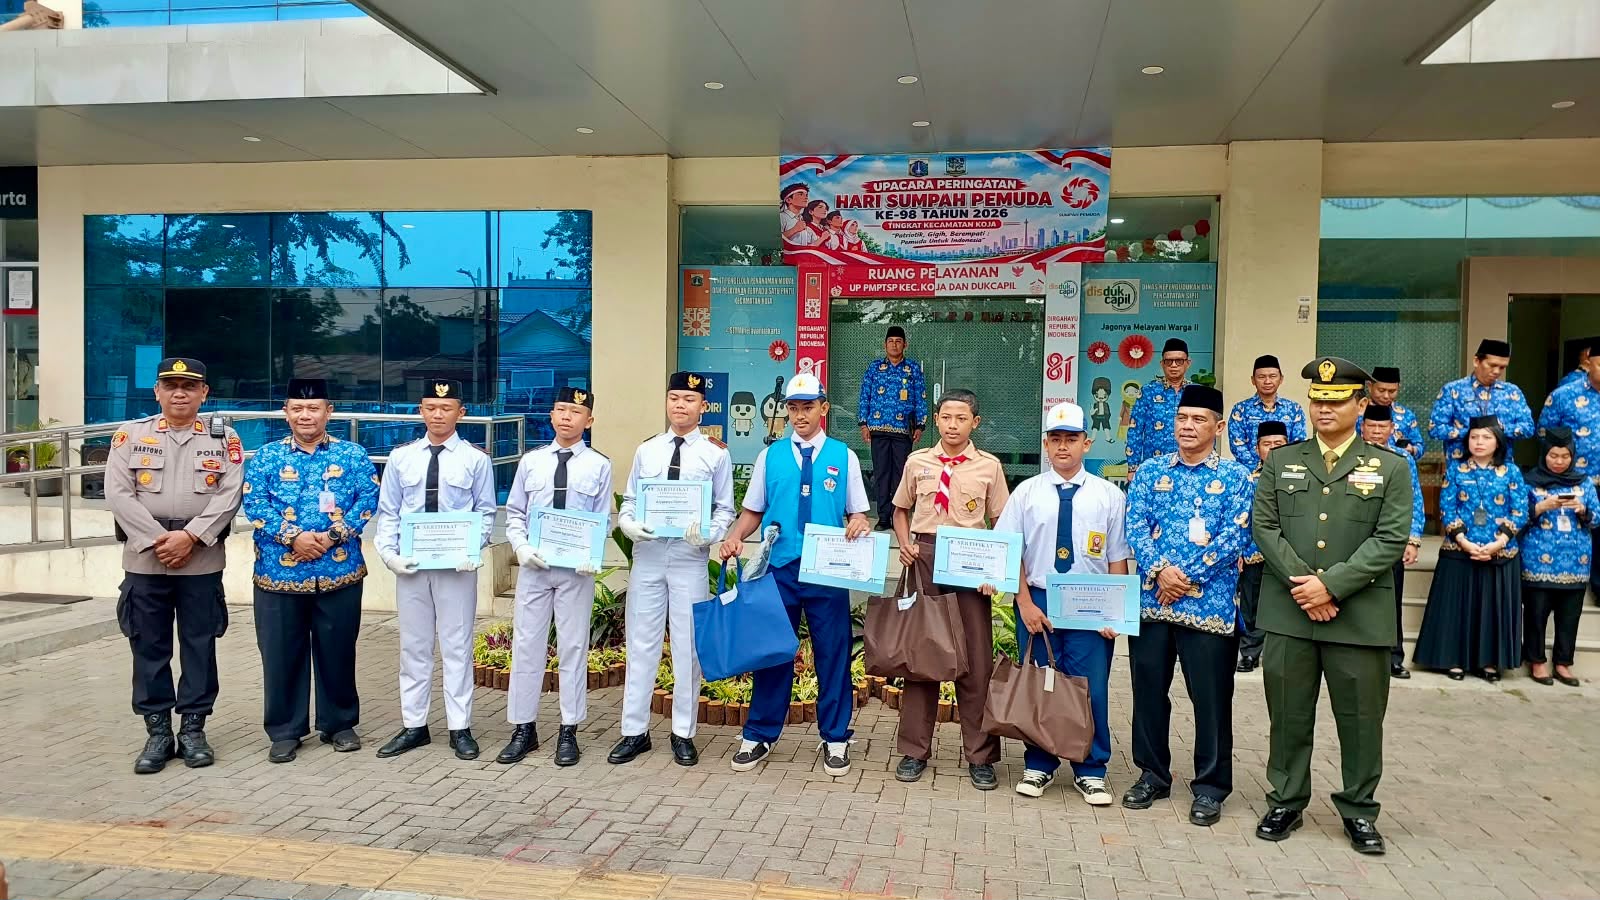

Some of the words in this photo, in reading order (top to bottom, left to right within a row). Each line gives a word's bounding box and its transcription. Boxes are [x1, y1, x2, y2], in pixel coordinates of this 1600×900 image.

[873, 180, 934, 192] UPACARA
[936, 178, 1018, 190] PERINGATAN
[0, 191, 27, 206] rta
[835, 193, 882, 209] HARI
[886, 192, 967, 209] SUMPAH
[970, 191, 1053, 207] PEMUDA
[875, 210, 917, 220] KE-98
[921, 209, 969, 219] TAHUN
[973, 208, 1009, 219] 2026
[888, 222, 923, 230] TINGKAT
[923, 221, 974, 229] KECAMATAN
[950, 230, 986, 239] Berempati
[868, 268, 916, 280] RUANG
[920, 266, 999, 279] PELAYANAN
[849, 283, 862, 292] UP
[863, 283, 898, 292] PMPTSP
[949, 282, 969, 291] DAN
[971, 281, 1017, 291] DUKCAPIL
[1049, 282, 1071, 290] disduk
[1086, 285, 1125, 297] disduk
[1059, 288, 1076, 297] capil
[1104, 293, 1131, 307] capil
[1101, 323, 1131, 332] Jagonya
[1133, 323, 1166, 332] Melayani
[1168, 323, 1192, 332] Warga
[1046, 352, 1076, 385] 81
[133, 445, 163, 455] HARTONO
[196, 450, 225, 458] POLRI
